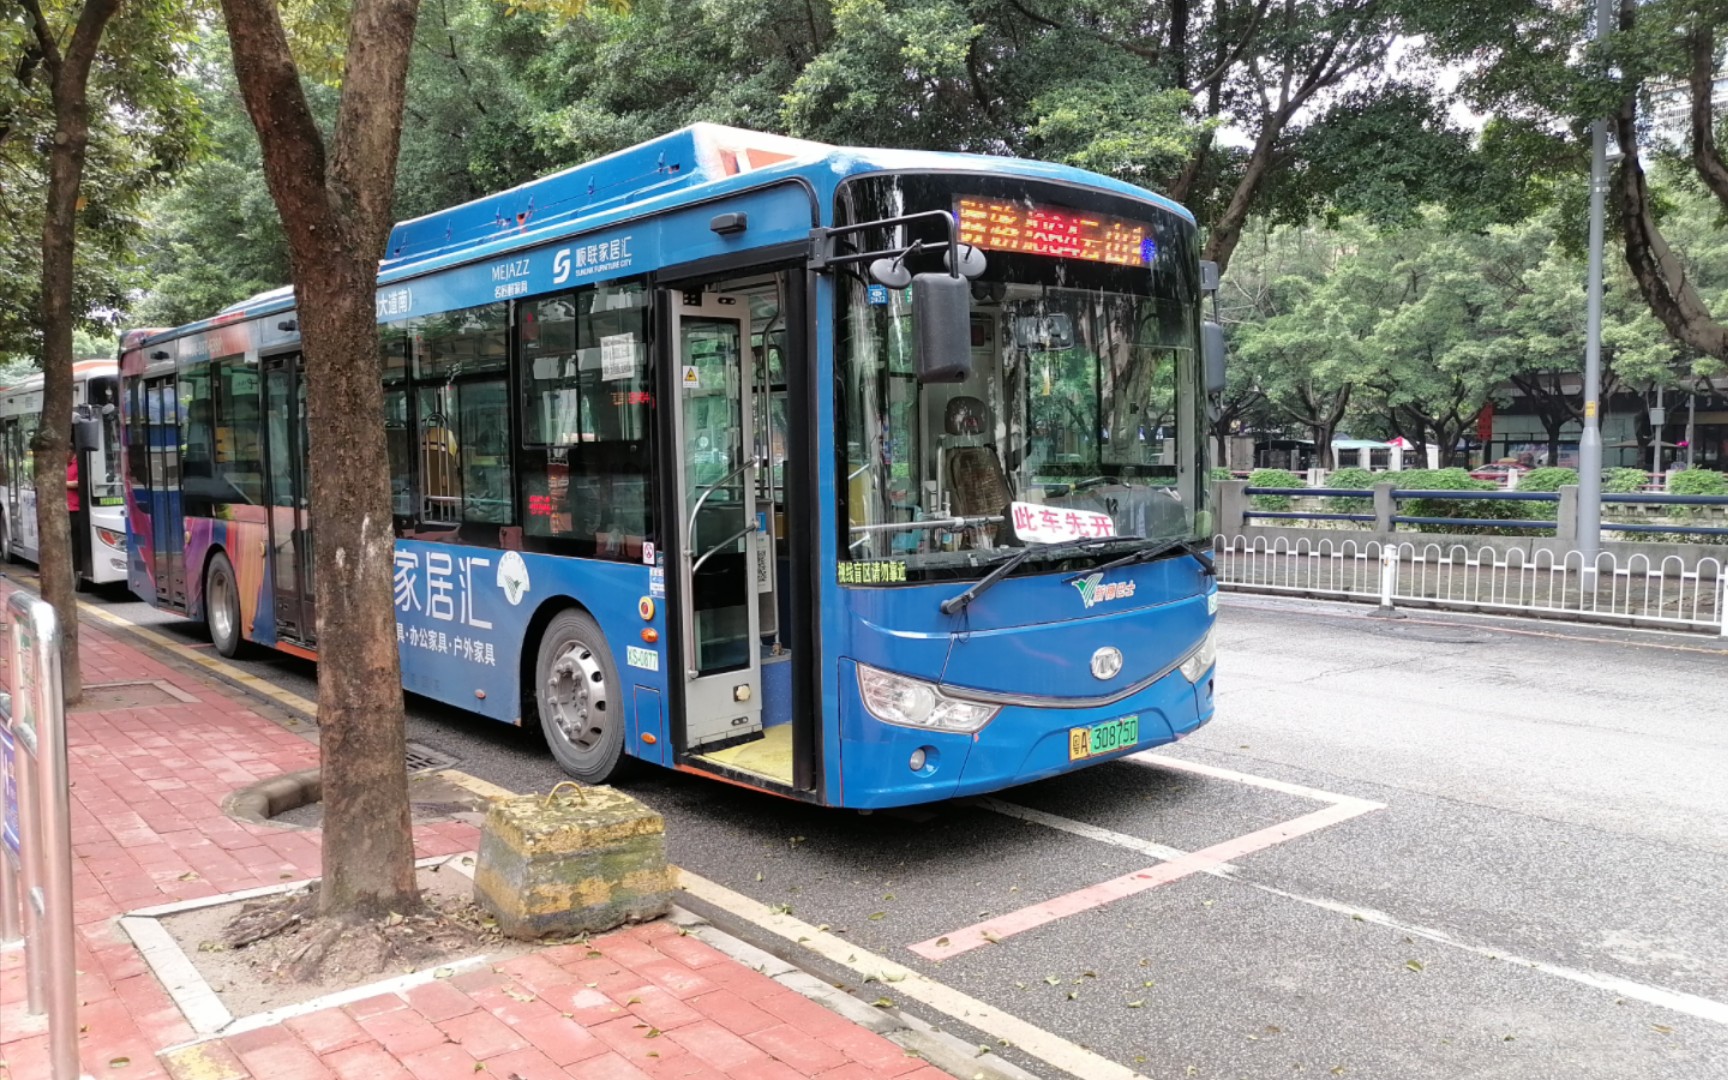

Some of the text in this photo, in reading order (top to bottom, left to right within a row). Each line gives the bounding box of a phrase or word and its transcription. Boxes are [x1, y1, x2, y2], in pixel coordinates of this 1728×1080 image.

[575, 235, 632, 267] 顺联家居汇
[491, 258, 530, 282] MEJAZZ
[1014, 505, 1112, 538] 此车先开
[393, 547, 492, 630] 家居汇
